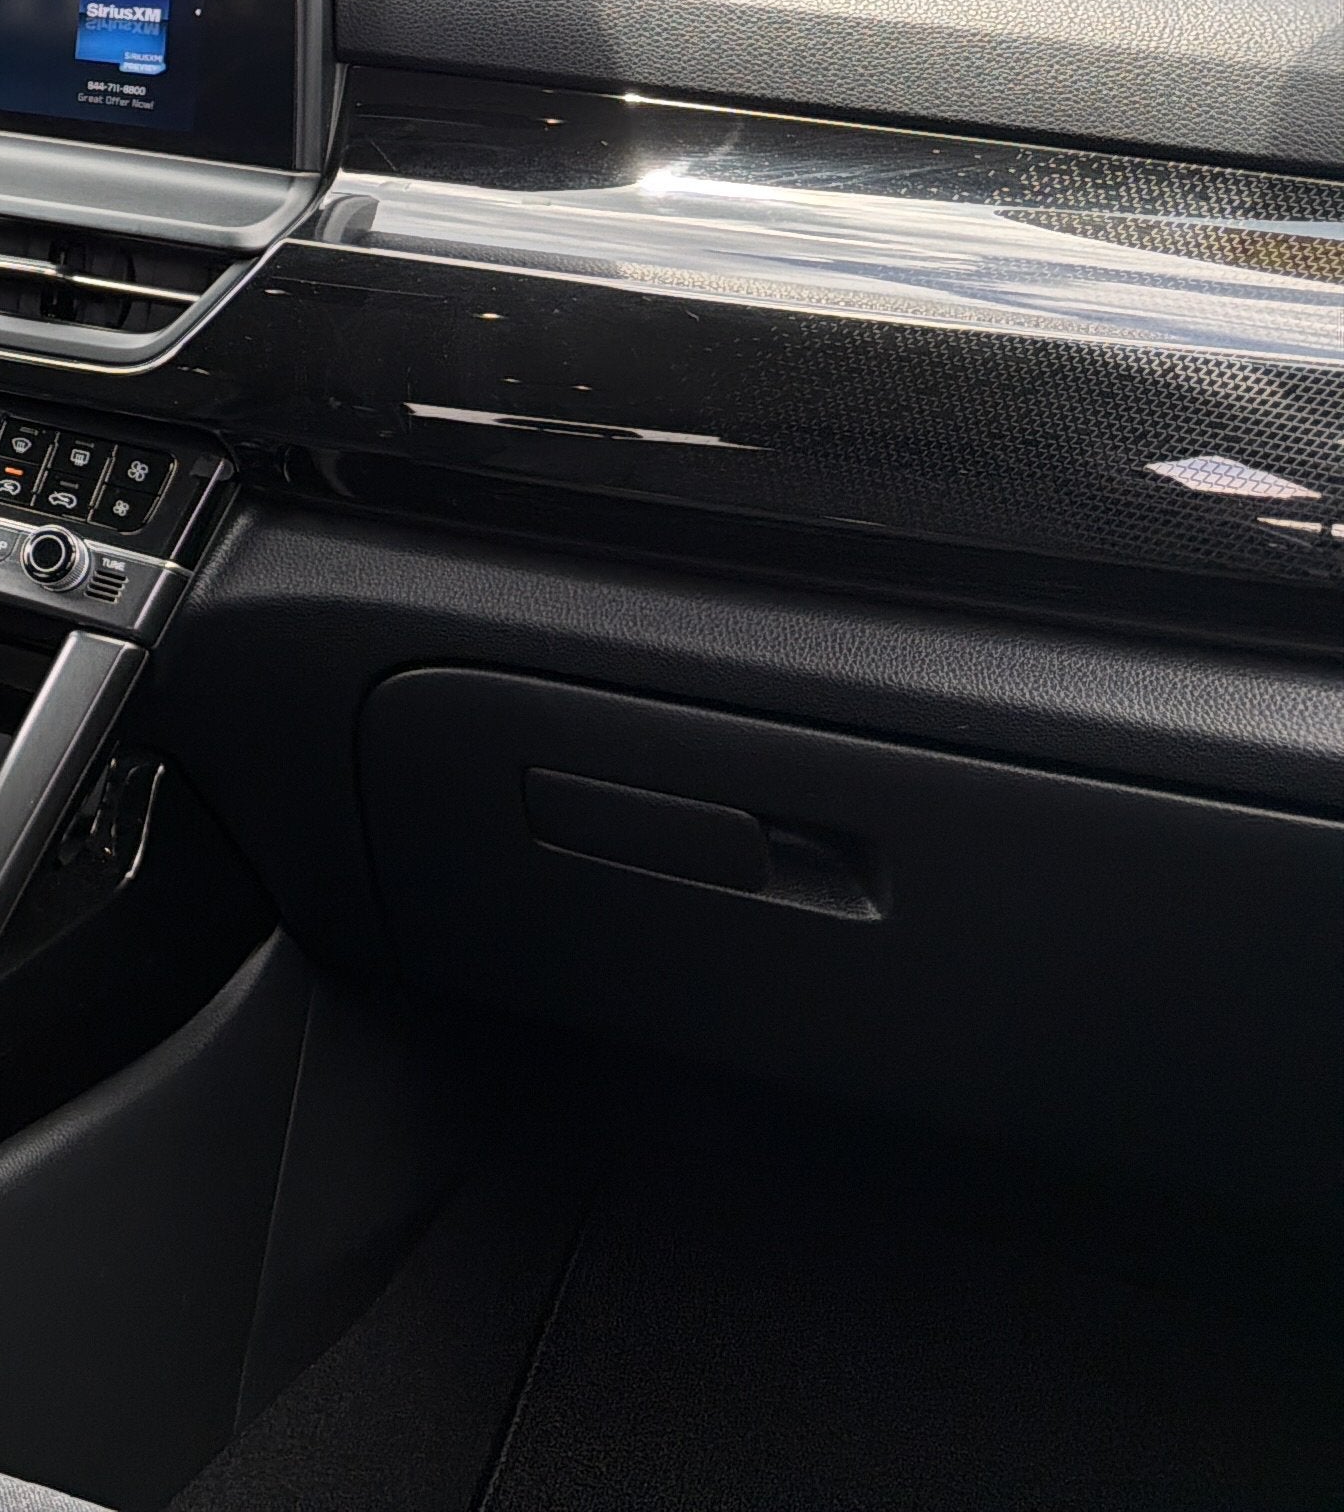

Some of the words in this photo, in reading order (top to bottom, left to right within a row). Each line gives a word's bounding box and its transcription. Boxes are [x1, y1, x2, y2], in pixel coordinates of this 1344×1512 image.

[86, 2, 162, 23] SiriusXM
[77, 92, 104, 104] Great
[105, 94, 130, 107] Offer
[131, 99, 155, 110] Now!
[101, 557, 126, 572] TUNE
